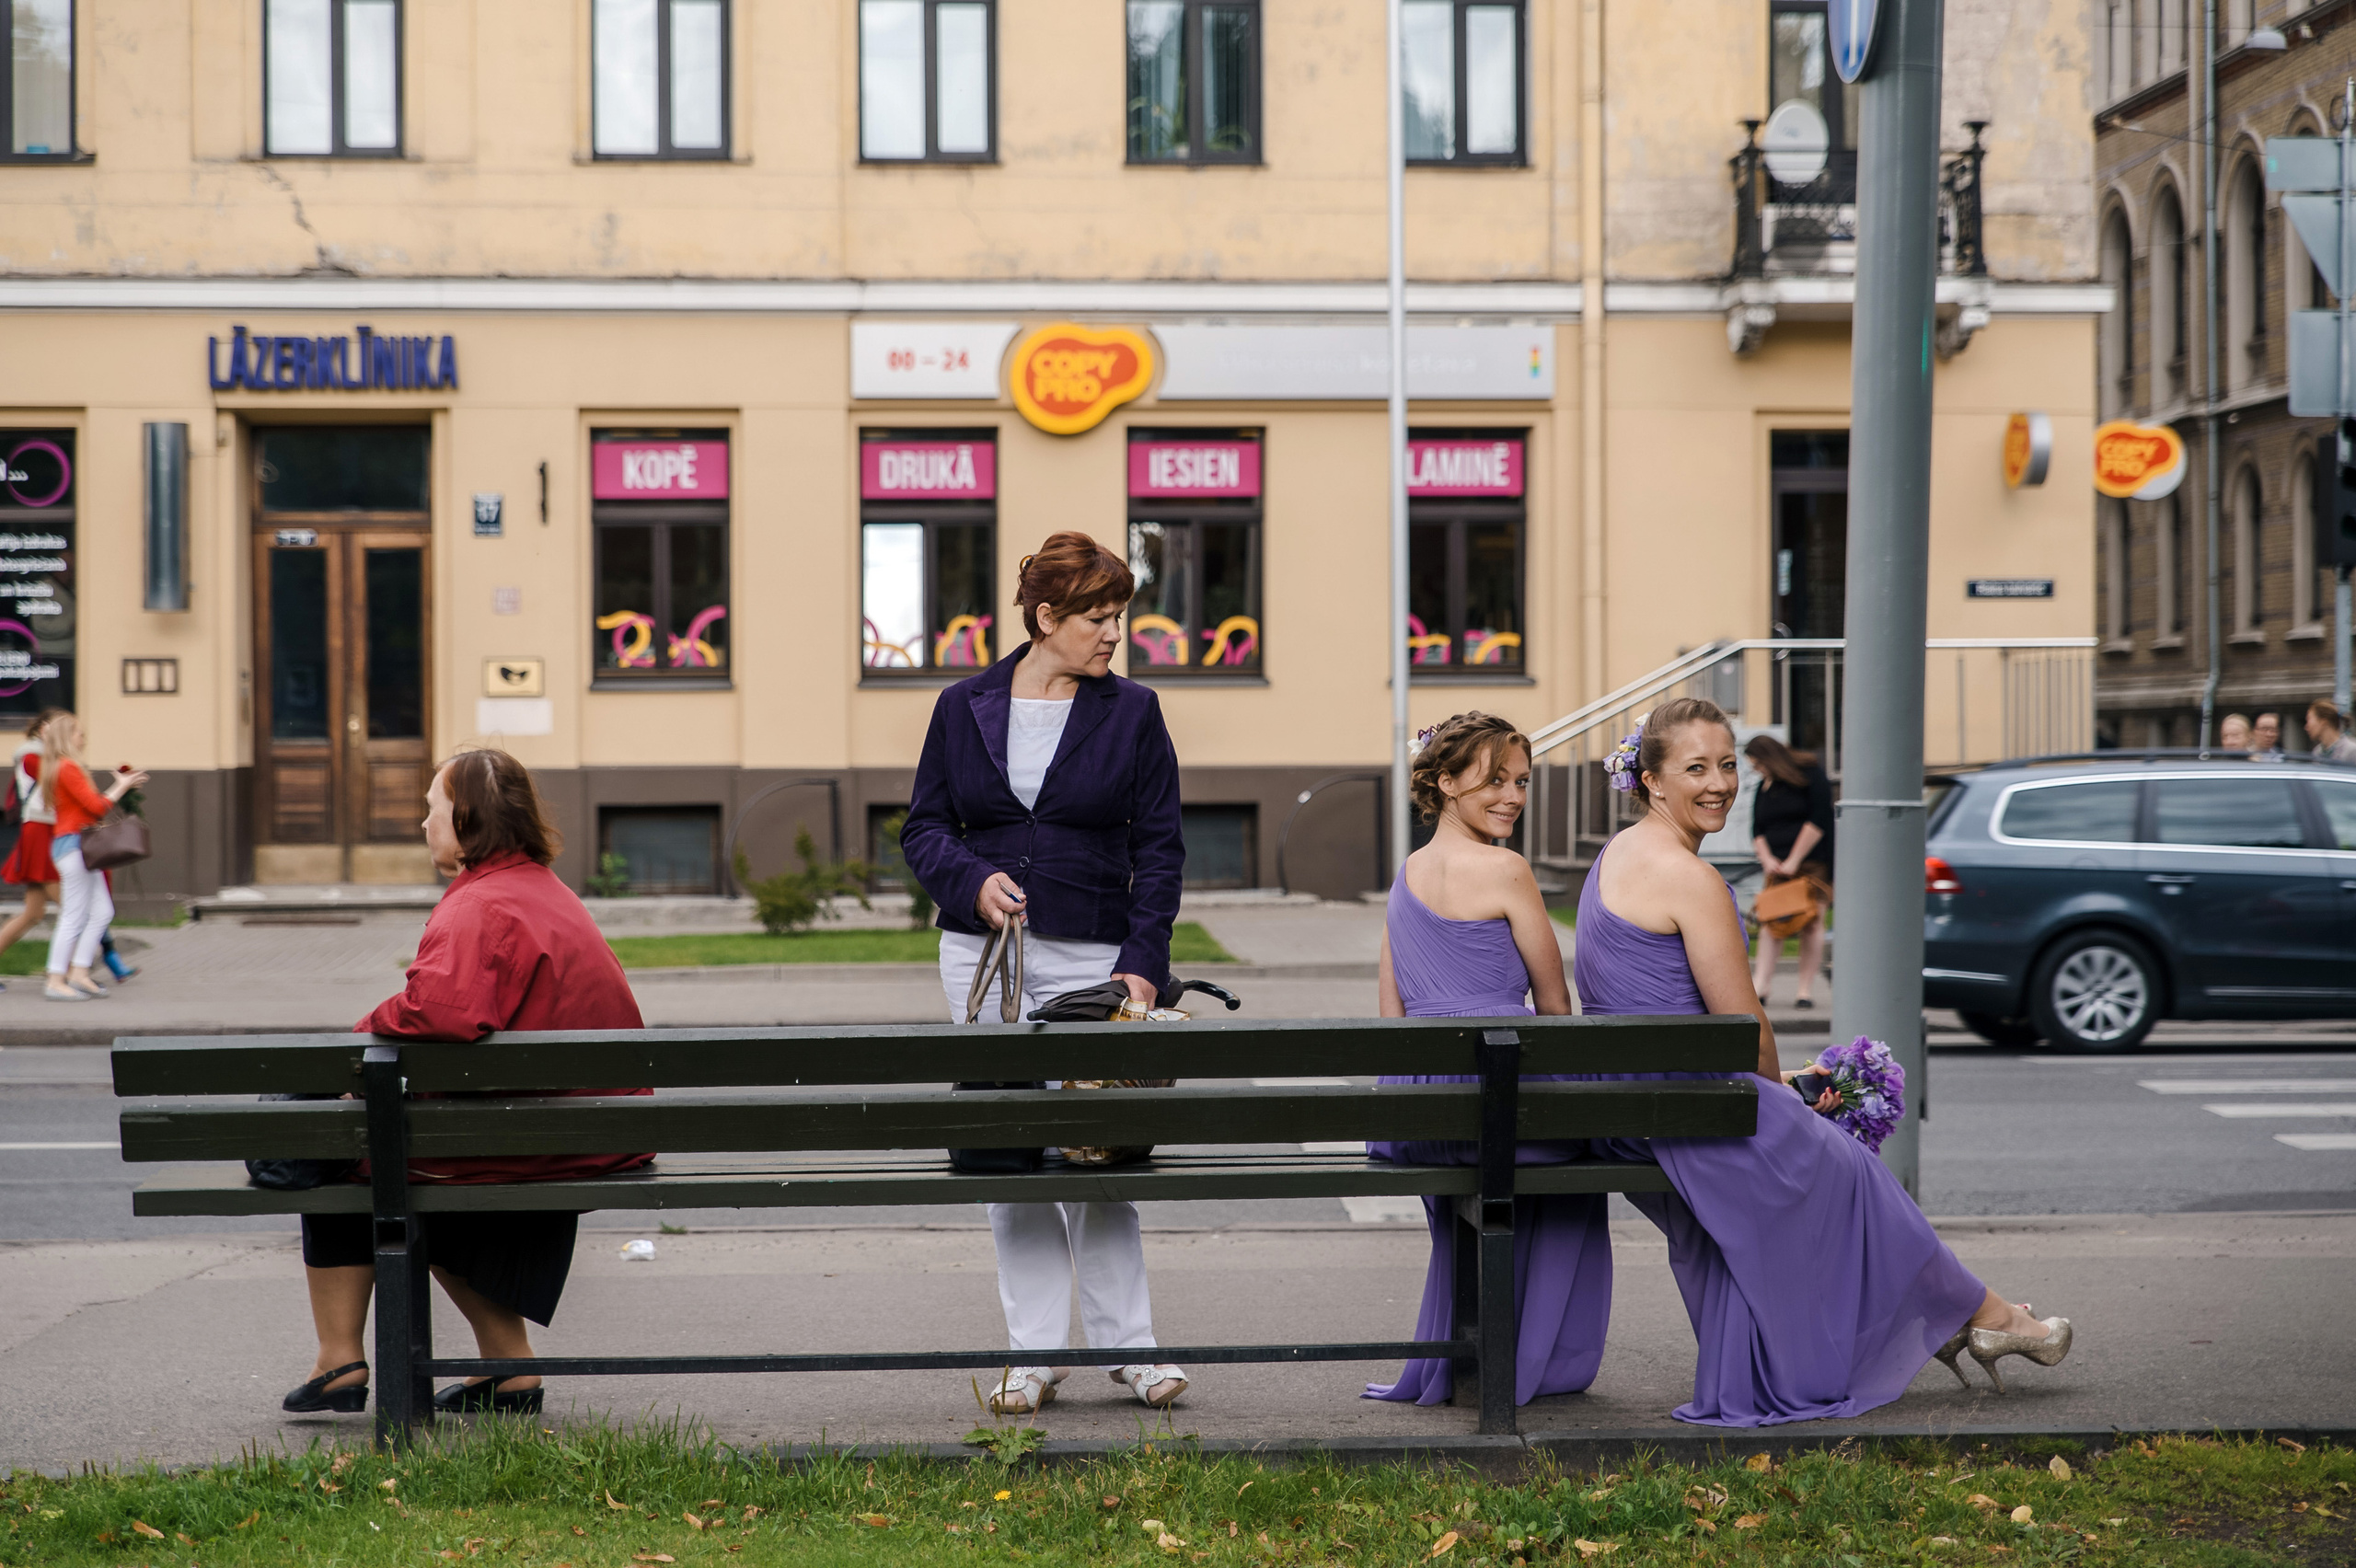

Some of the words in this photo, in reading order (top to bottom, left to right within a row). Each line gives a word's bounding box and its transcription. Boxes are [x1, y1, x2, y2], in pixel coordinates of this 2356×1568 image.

[209, 326, 457, 390] LĀZERKLĪNIKA
[887, 349, 916, 372] 00
[941, 349, 970, 372] 24
[1031, 350, 1119, 379] COPY
[1033, 374, 1103, 402] PRO
[622, 444, 698, 490] KOPĒ
[879, 444, 976, 490] DRUKĀ
[1405, 442, 1510, 487] LAMINĒ
[2099, 439, 2159, 461] COPY
[1149, 448, 1240, 488] IESIEN
[2100, 459, 2146, 478] PRO
